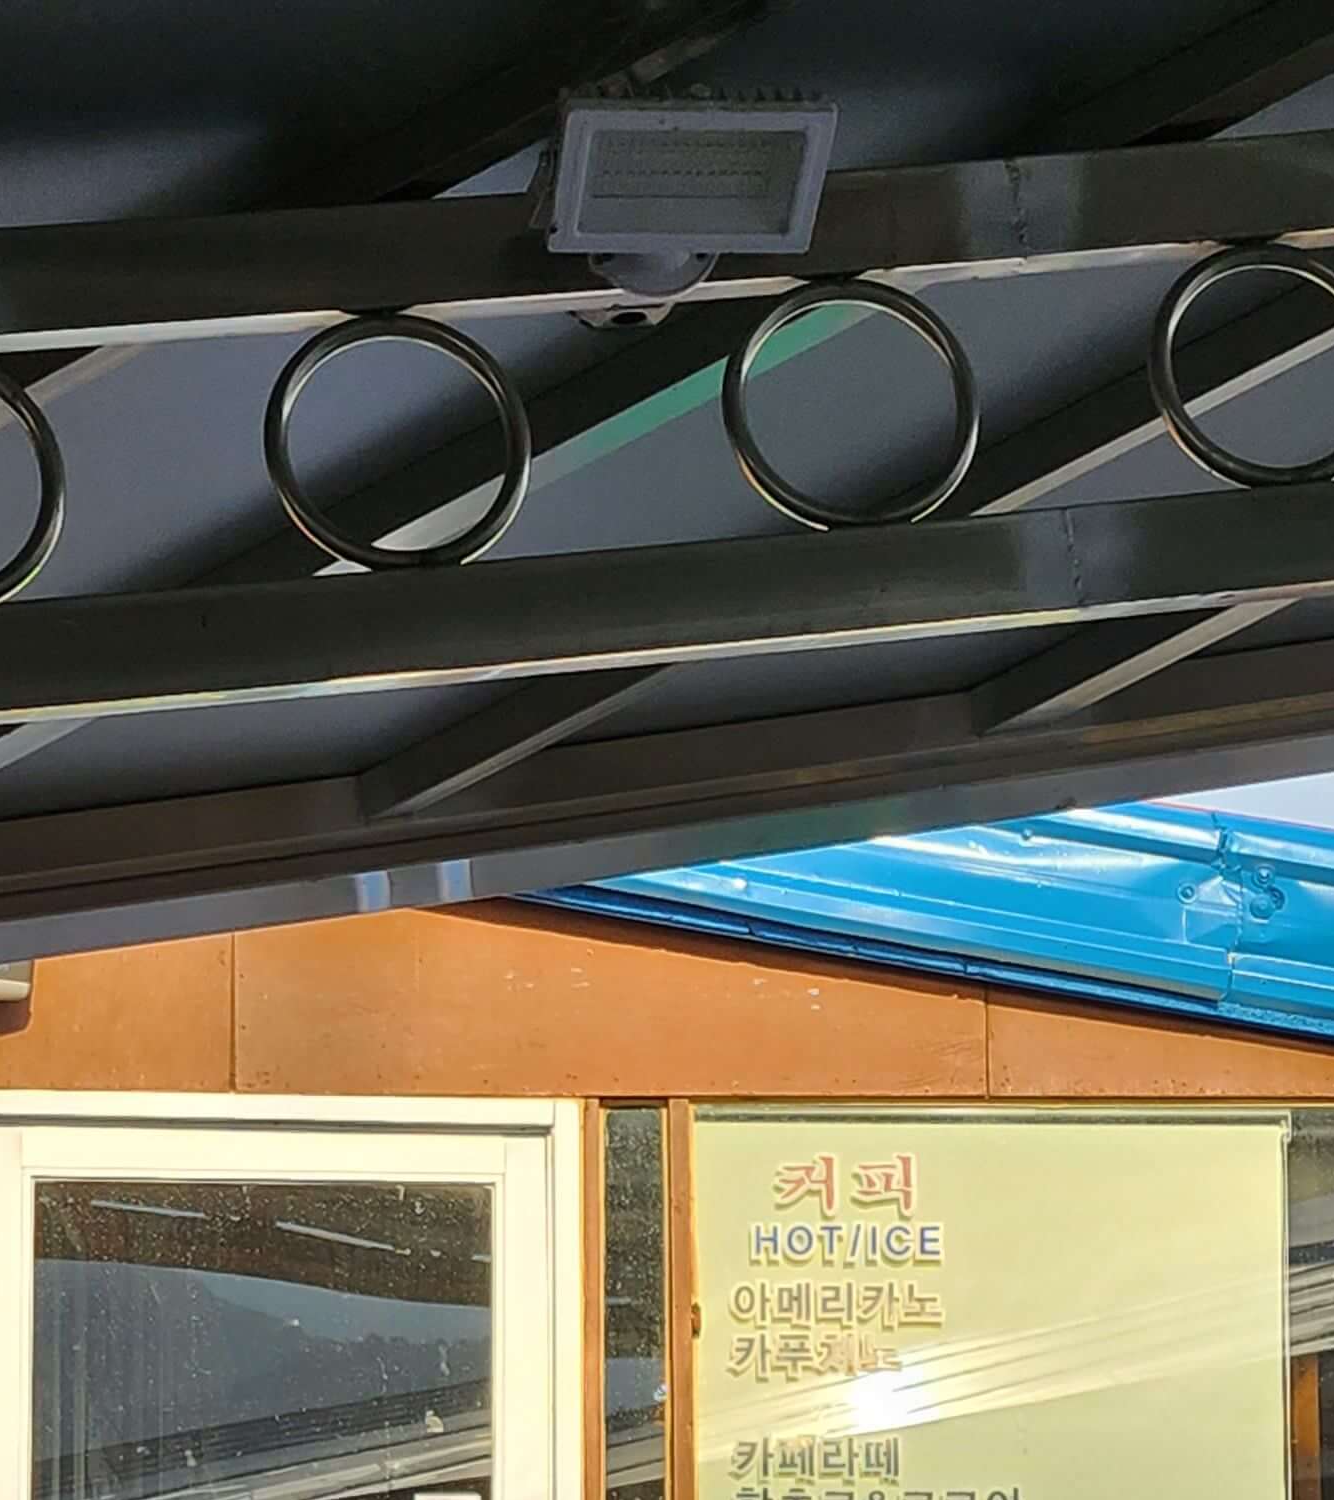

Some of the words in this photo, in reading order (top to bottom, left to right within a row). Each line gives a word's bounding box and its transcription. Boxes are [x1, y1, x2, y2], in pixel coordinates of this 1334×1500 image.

[774, 1153, 918, 1211] 커피
[752, 1223, 943, 1259] HOT/ICE
[732, 1281, 944, 1323] 아메리카노
[734, 1436, 901, 1478] 카페라떼
